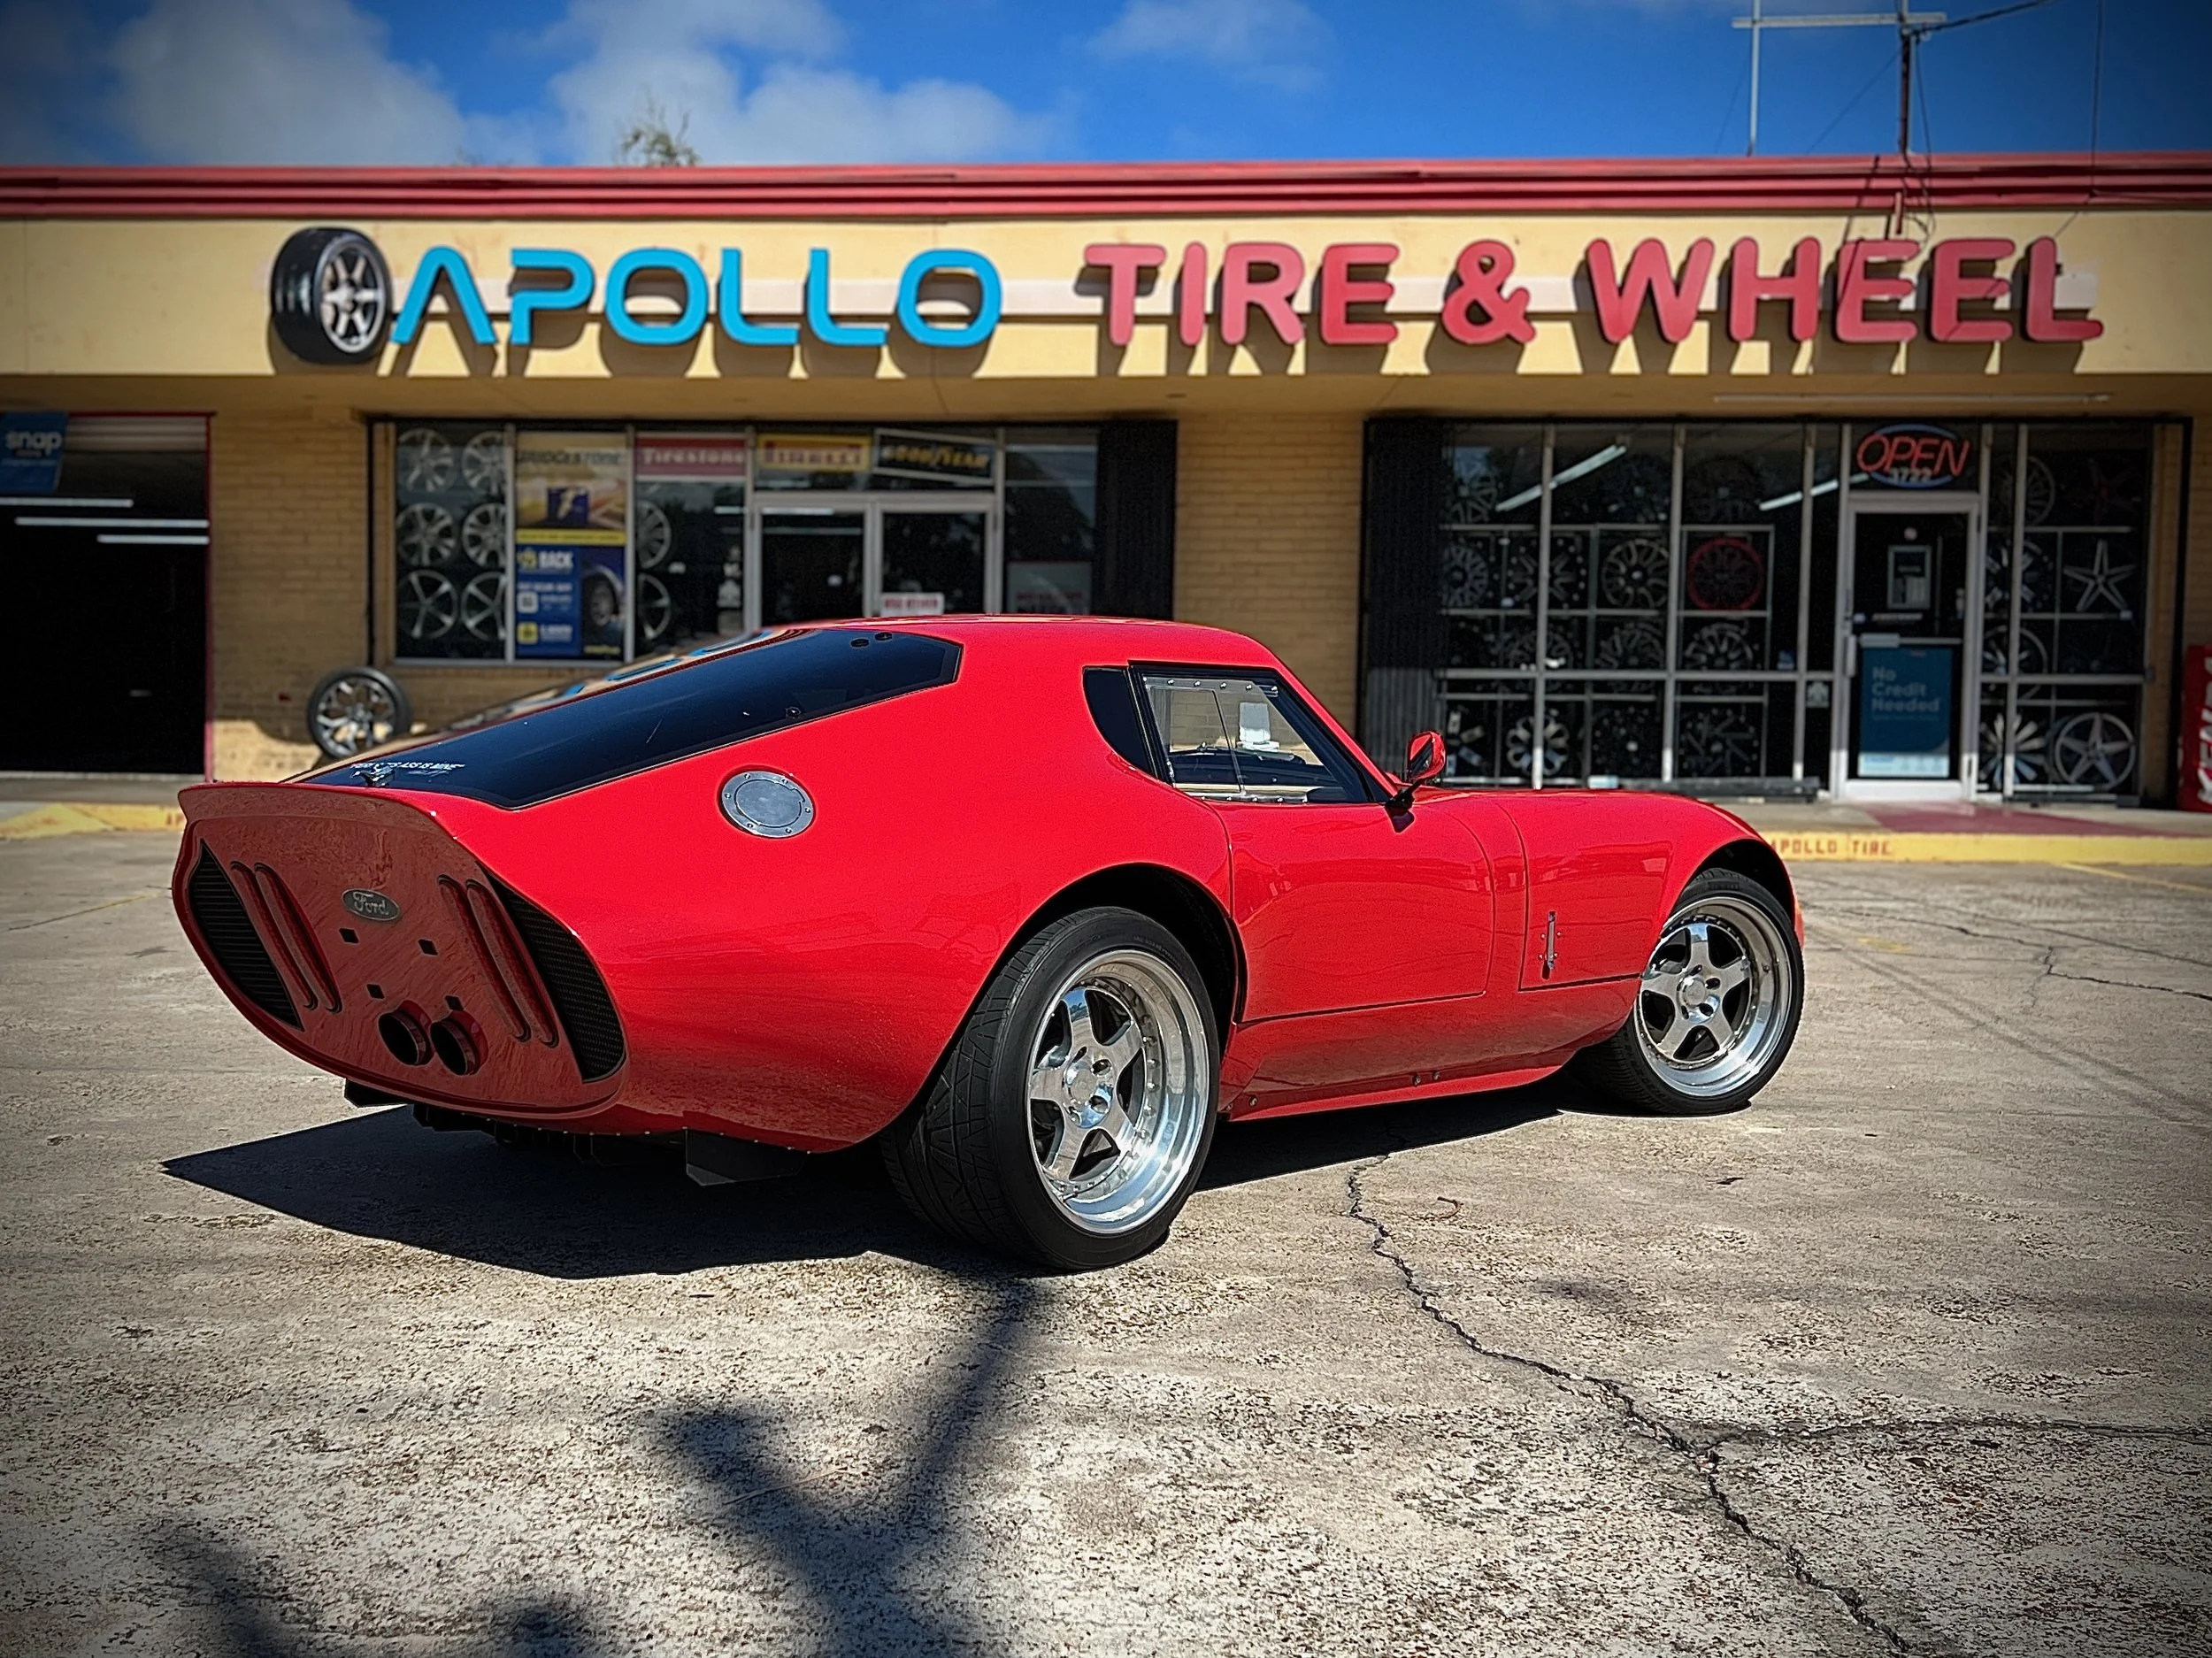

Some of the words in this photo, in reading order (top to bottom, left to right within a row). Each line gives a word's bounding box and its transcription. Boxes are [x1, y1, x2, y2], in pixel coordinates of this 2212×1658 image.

[390, 247, 1002, 346] APOLLO
[1085, 242, 1400, 346] TIRE
[1441, 242, 1537, 344] &
[1588, 237, 2104, 344] WHEEL
[6, 431, 62, 457] snap
[1856, 434, 1970, 476] OPEN
[1871, 666, 1896, 682] No
[1871, 682, 1926, 697] Credit
[1871, 698, 1940, 712] Needed
[353, 891, 389, 915] Ford
